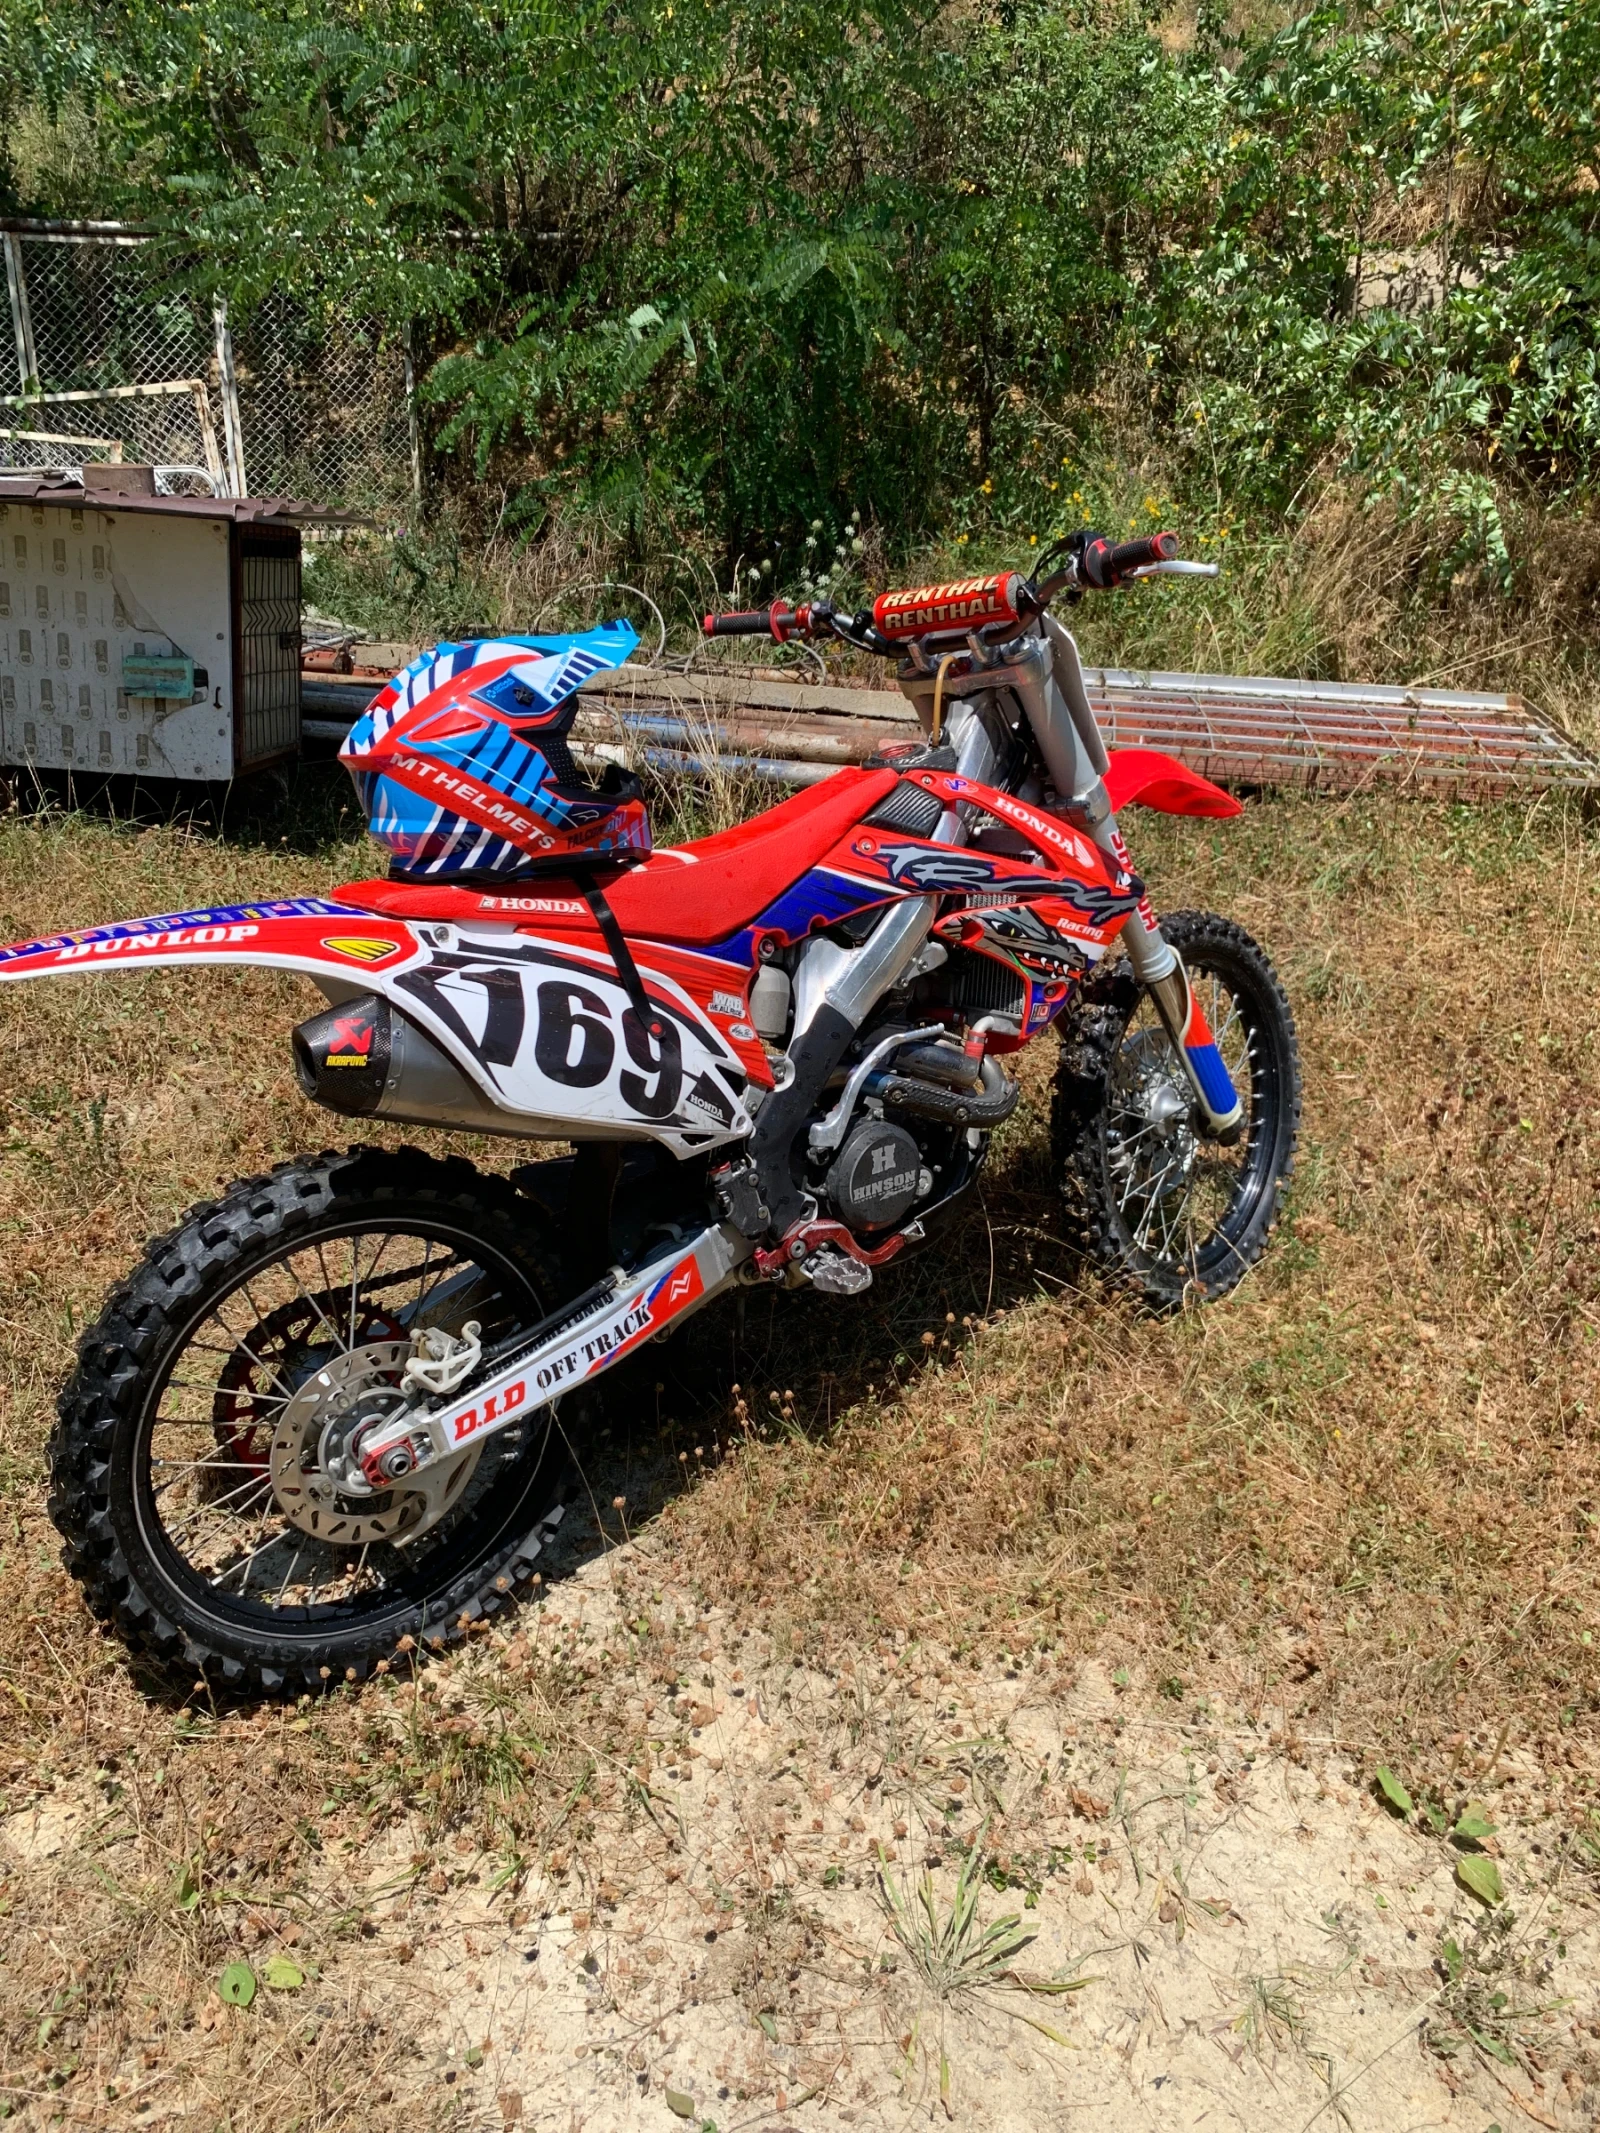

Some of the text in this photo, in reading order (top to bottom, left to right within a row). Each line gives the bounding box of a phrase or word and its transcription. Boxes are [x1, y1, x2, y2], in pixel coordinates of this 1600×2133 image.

[881, 576, 1000, 609] RENTHAL
[885, 595, 1003, 630] RENTHAL
[993, 796, 1075, 860] HONDA
[501, 897, 588, 915] HONDA
[54, 925, 260, 961] DUNLOP
[1056, 917, 1105, 940] Racing
[690, 1093, 724, 1119] HONDA
[871, 1143, 896, 1175] H
[853, 1169, 916, 1202] HINSON
[454, 1380, 525, 1441] D.I.D
[536, 1352, 579, 1389] OFF
[580, 1303, 652, 1364] TRACK
